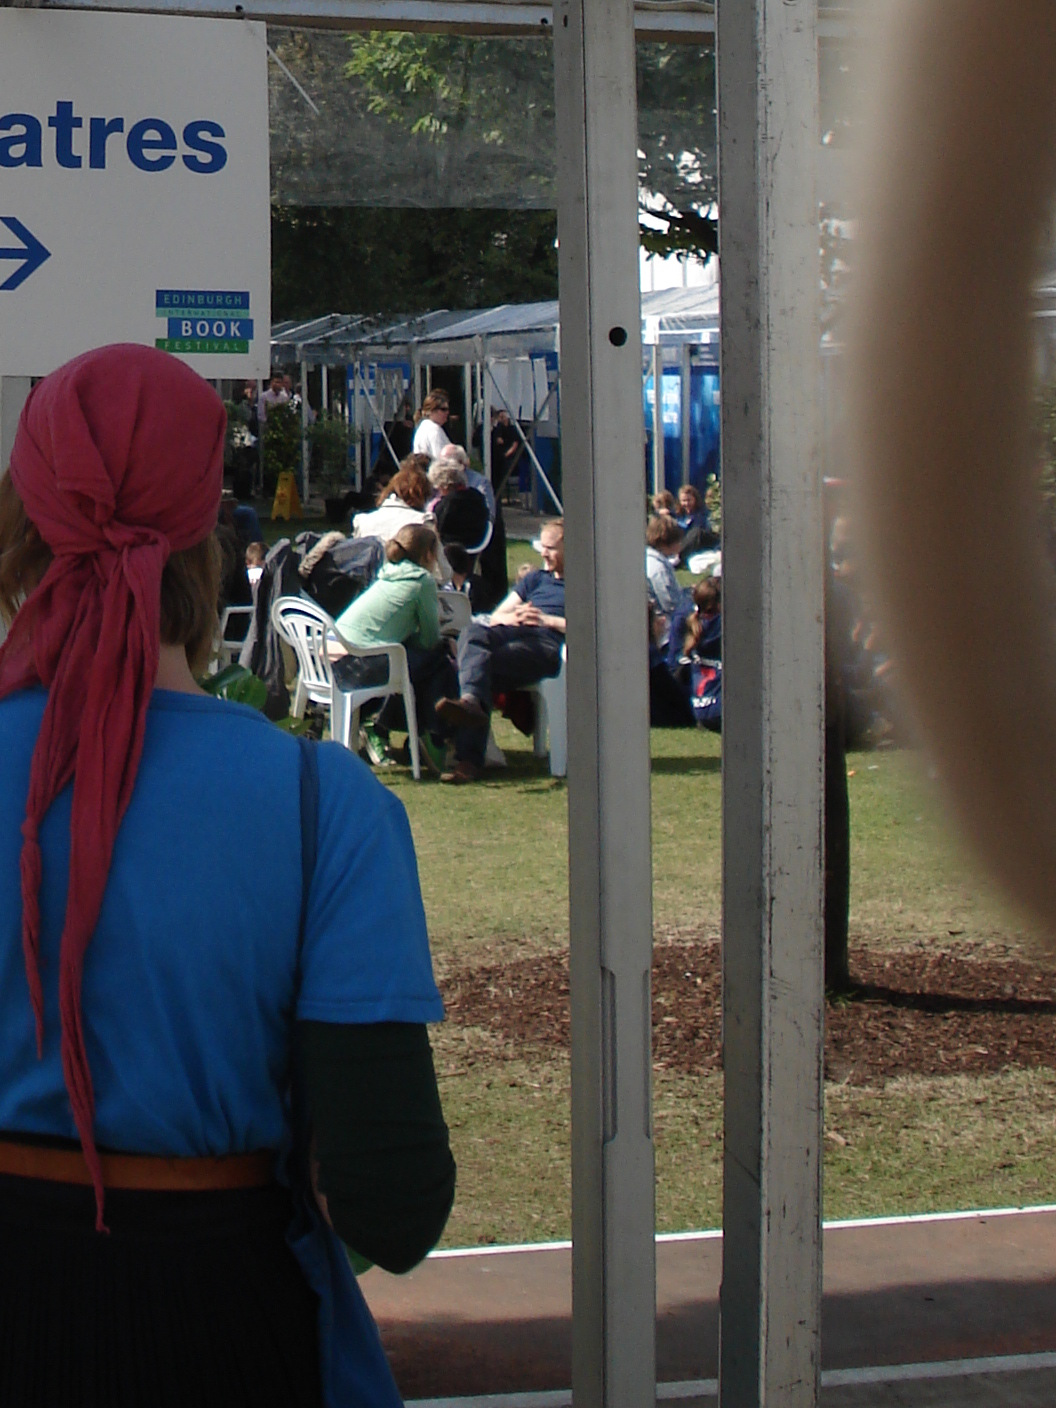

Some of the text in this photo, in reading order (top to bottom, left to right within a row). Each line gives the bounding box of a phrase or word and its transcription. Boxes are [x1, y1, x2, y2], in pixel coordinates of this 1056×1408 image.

[163, 294, 242, 305] EDINBURGH
[181, 320, 241, 337] BOOK
[163, 341, 240, 351] FESTIVAL
